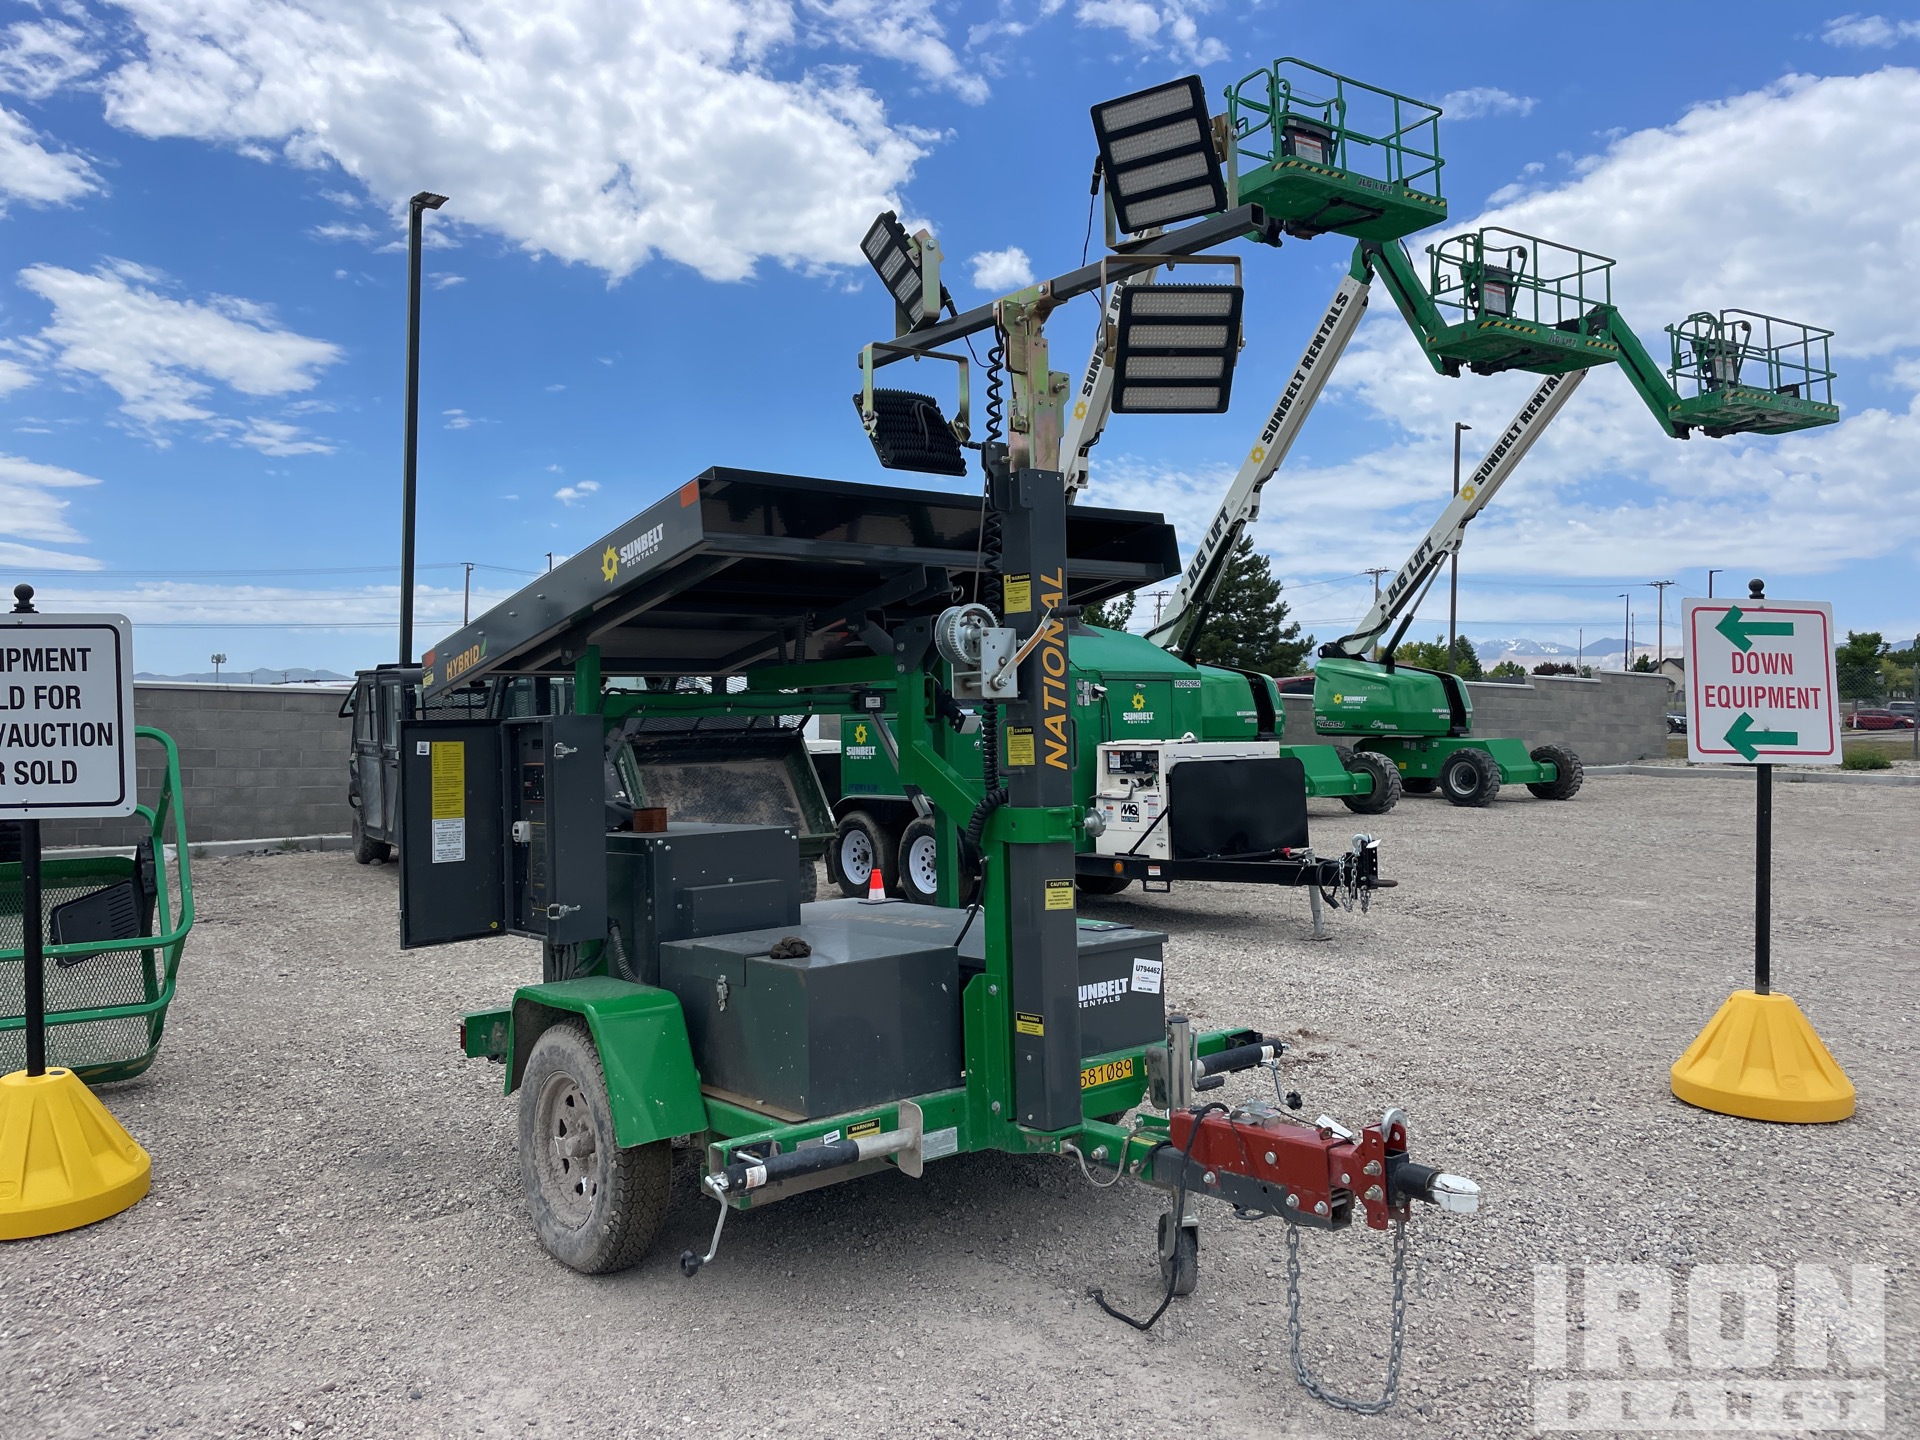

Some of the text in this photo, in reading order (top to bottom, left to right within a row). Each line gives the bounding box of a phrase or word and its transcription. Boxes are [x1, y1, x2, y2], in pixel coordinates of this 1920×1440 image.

[1262, 291, 1349, 444] SUNBELT RENTALS
[1474, 372, 1565, 485] SUNBELT RENTAL
[620, 522, 663, 564] SUNBELT
[1187, 506, 1231, 589] JLG LIFT
[626, 544, 659, 568] RENTALS
[1387, 536, 1434, 605] JLG LIFT
[446, 644, 480, 682] HYBRID
[1731, 651, 1793, 675] DOWN
[34, 685, 81, 710] FOR
[1704, 685, 1821, 710] EQUIPMENT
[1122, 711, 1154, 721] SUNBELT
[846, 746, 876, 756] SUNBELT
[14, 760, 77, 785] SOLD
[1121, 803, 1139, 816] MQ
[1078, 978, 1128, 1002] UNBELT
[851, 1121, 876, 1132] WARNING
